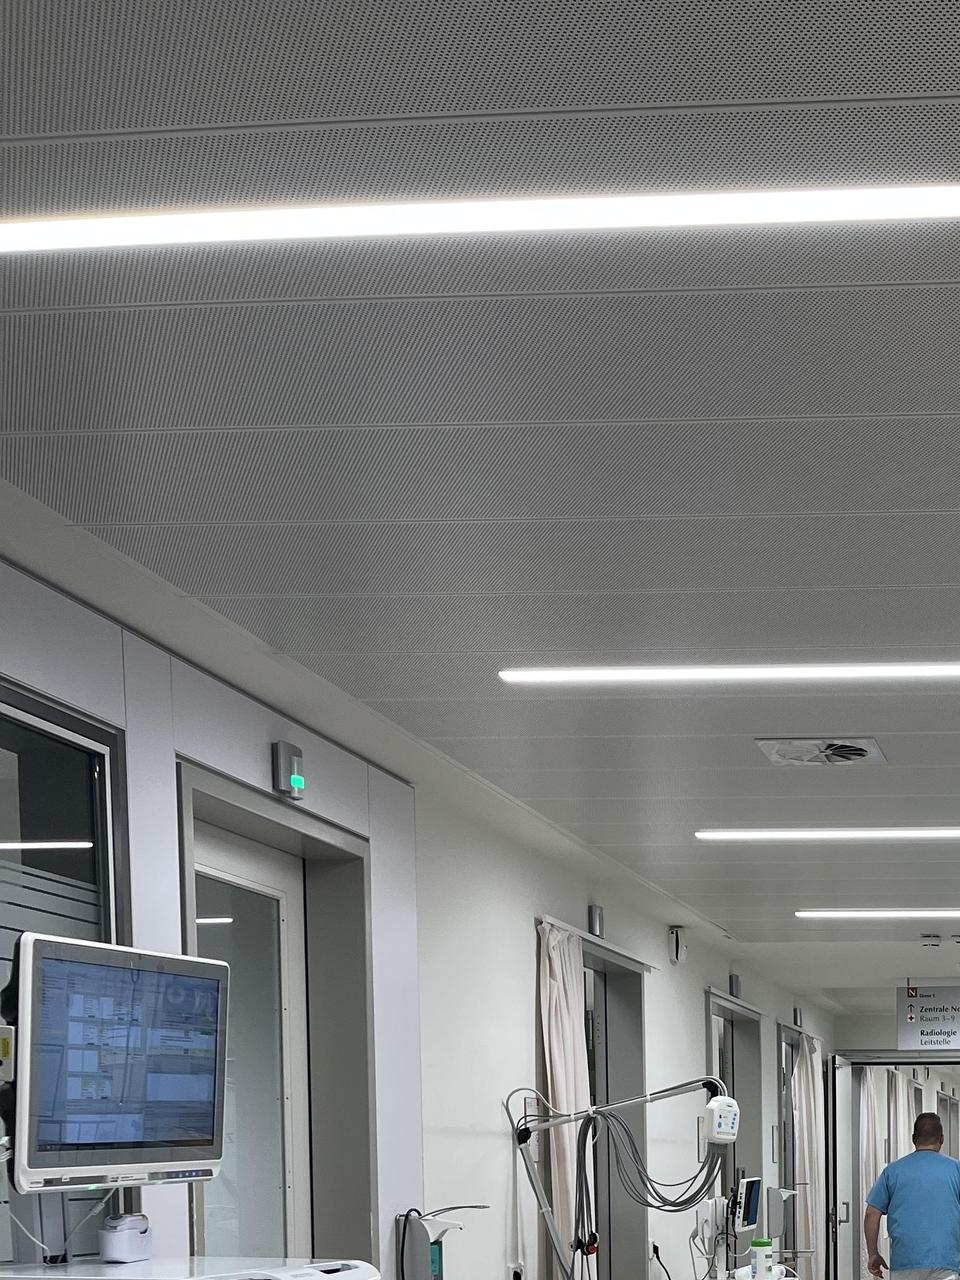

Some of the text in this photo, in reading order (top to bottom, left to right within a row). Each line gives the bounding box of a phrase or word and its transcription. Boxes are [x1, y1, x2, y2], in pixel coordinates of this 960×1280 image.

[919, 1005, 950, 1013] Zentrale
[920, 1029, 957, 1038] Radiologie
[920, 1038, 951, 1046] Leitstelle
